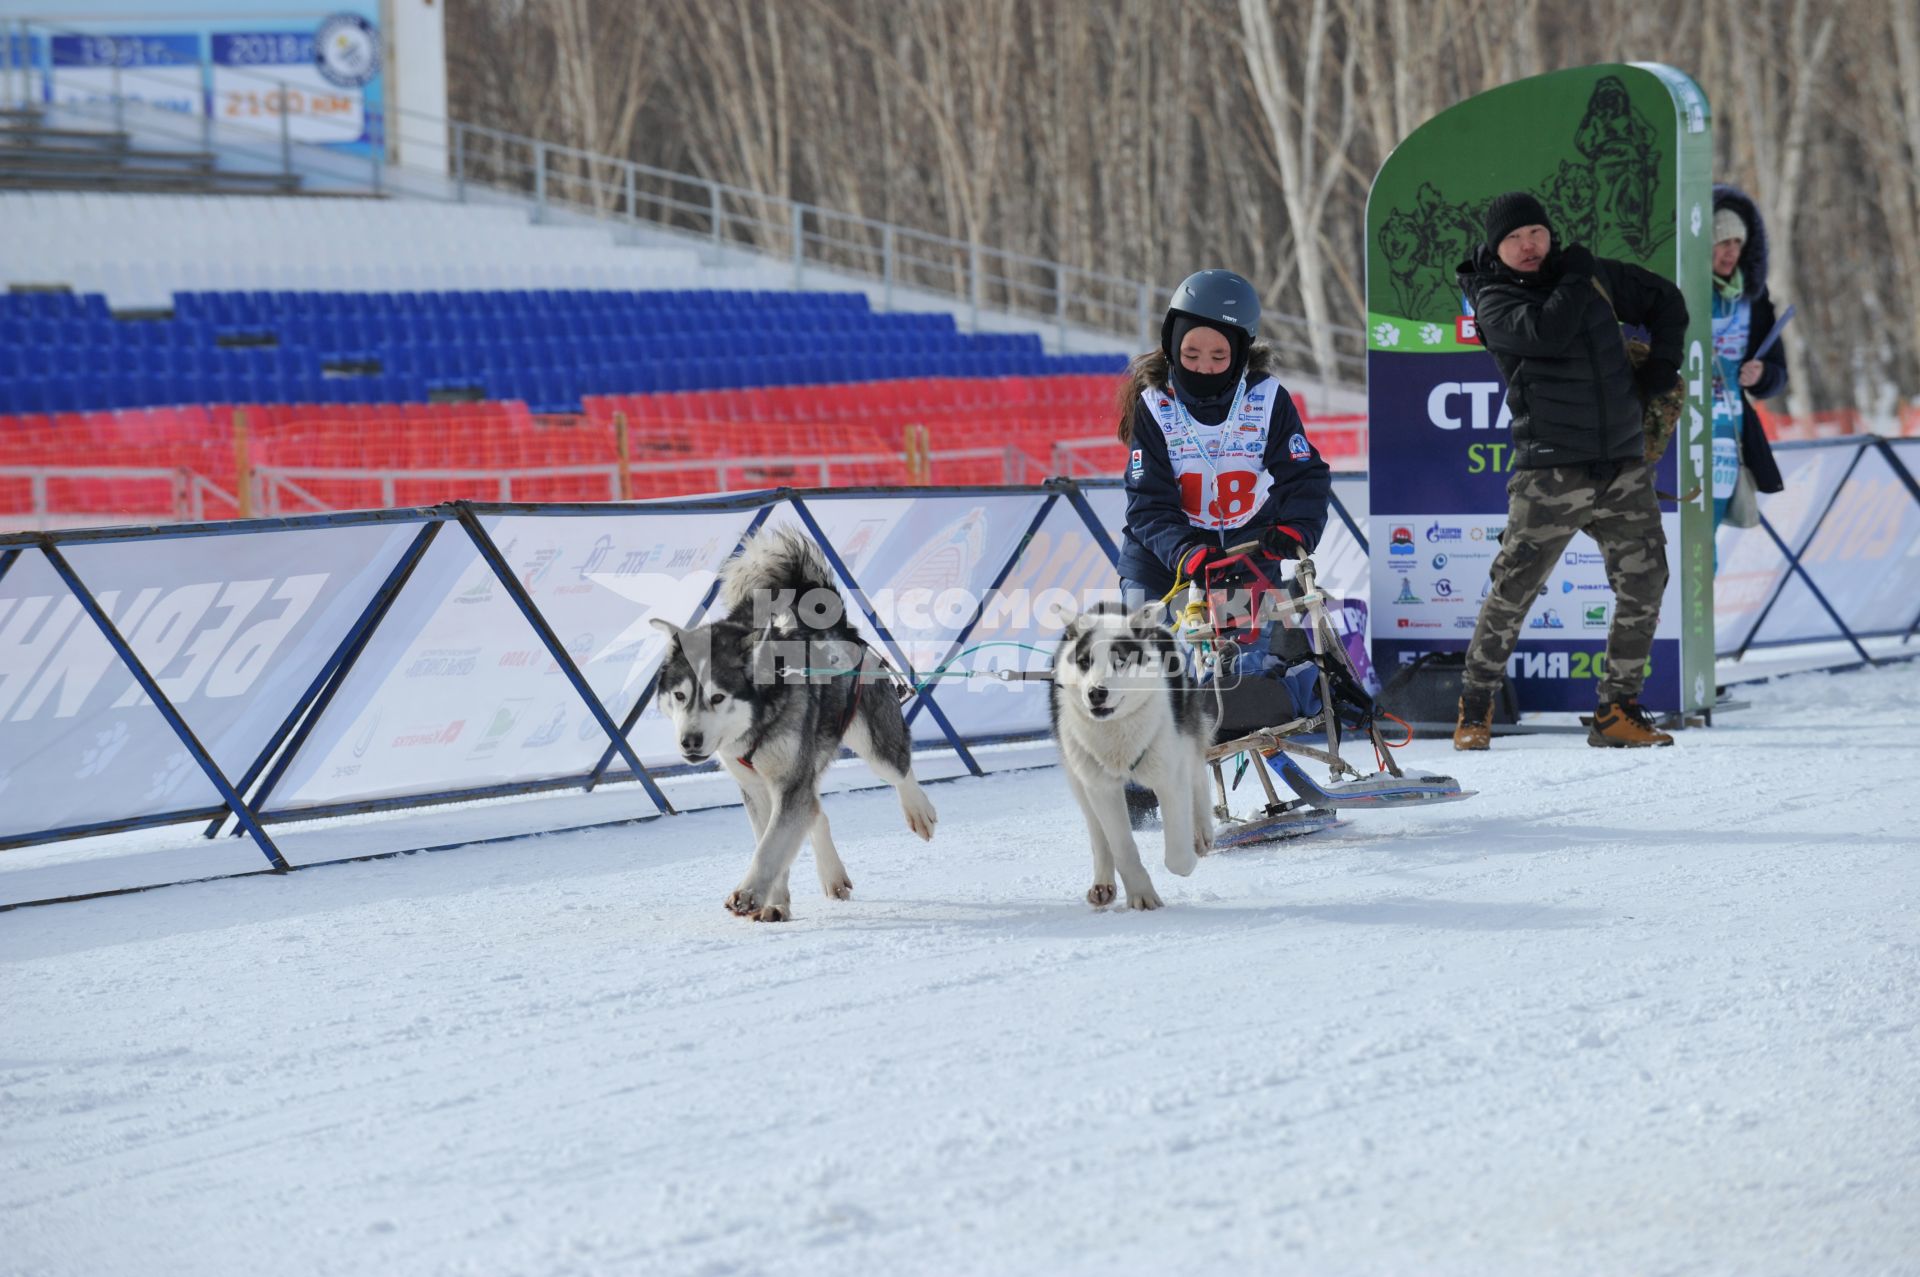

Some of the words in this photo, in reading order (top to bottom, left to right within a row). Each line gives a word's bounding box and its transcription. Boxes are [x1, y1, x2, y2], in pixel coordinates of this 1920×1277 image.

[226, 90, 304, 117] 2100
[1689, 340, 1705, 512] СТАРТ
[1180, 470, 1258, 519] 18
